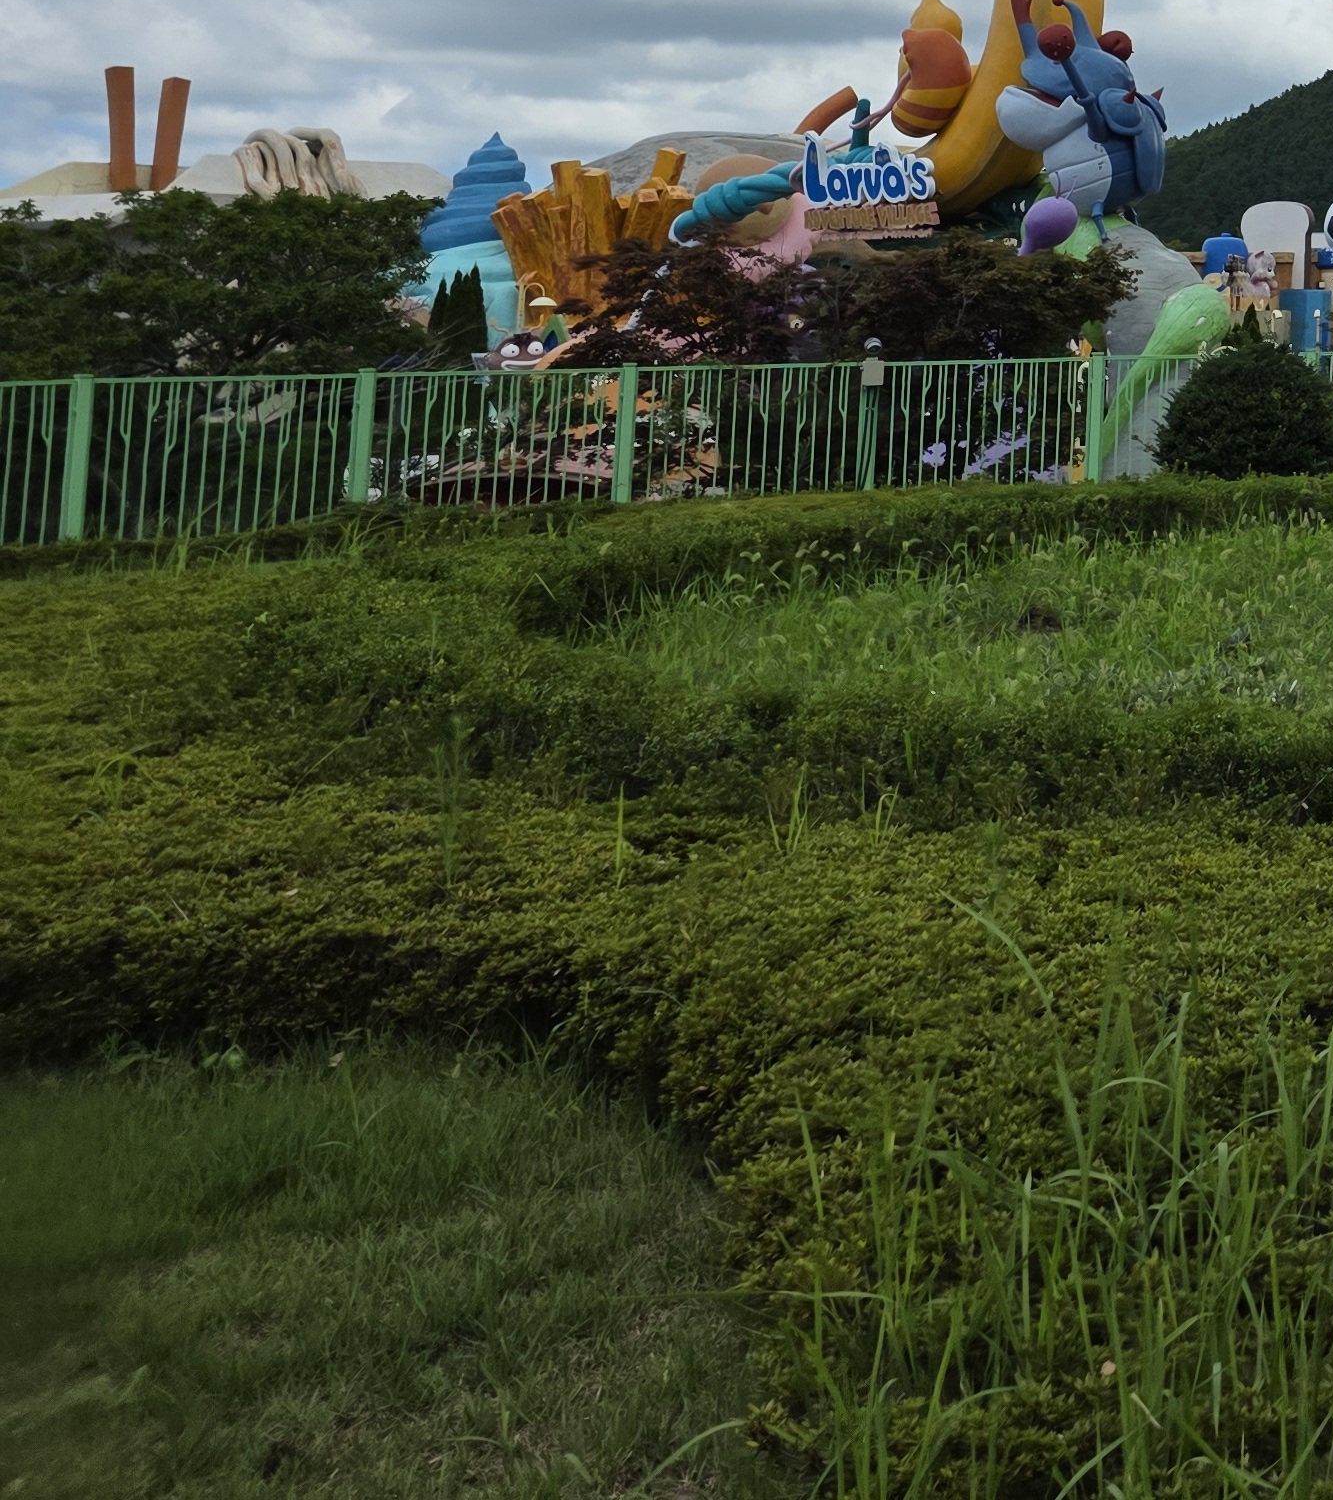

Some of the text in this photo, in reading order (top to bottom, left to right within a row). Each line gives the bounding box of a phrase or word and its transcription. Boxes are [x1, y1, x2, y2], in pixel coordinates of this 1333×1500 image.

[804, 132, 931, 204] Larva's
[805, 202, 935, 229] ADVENTURE VILLAGE
